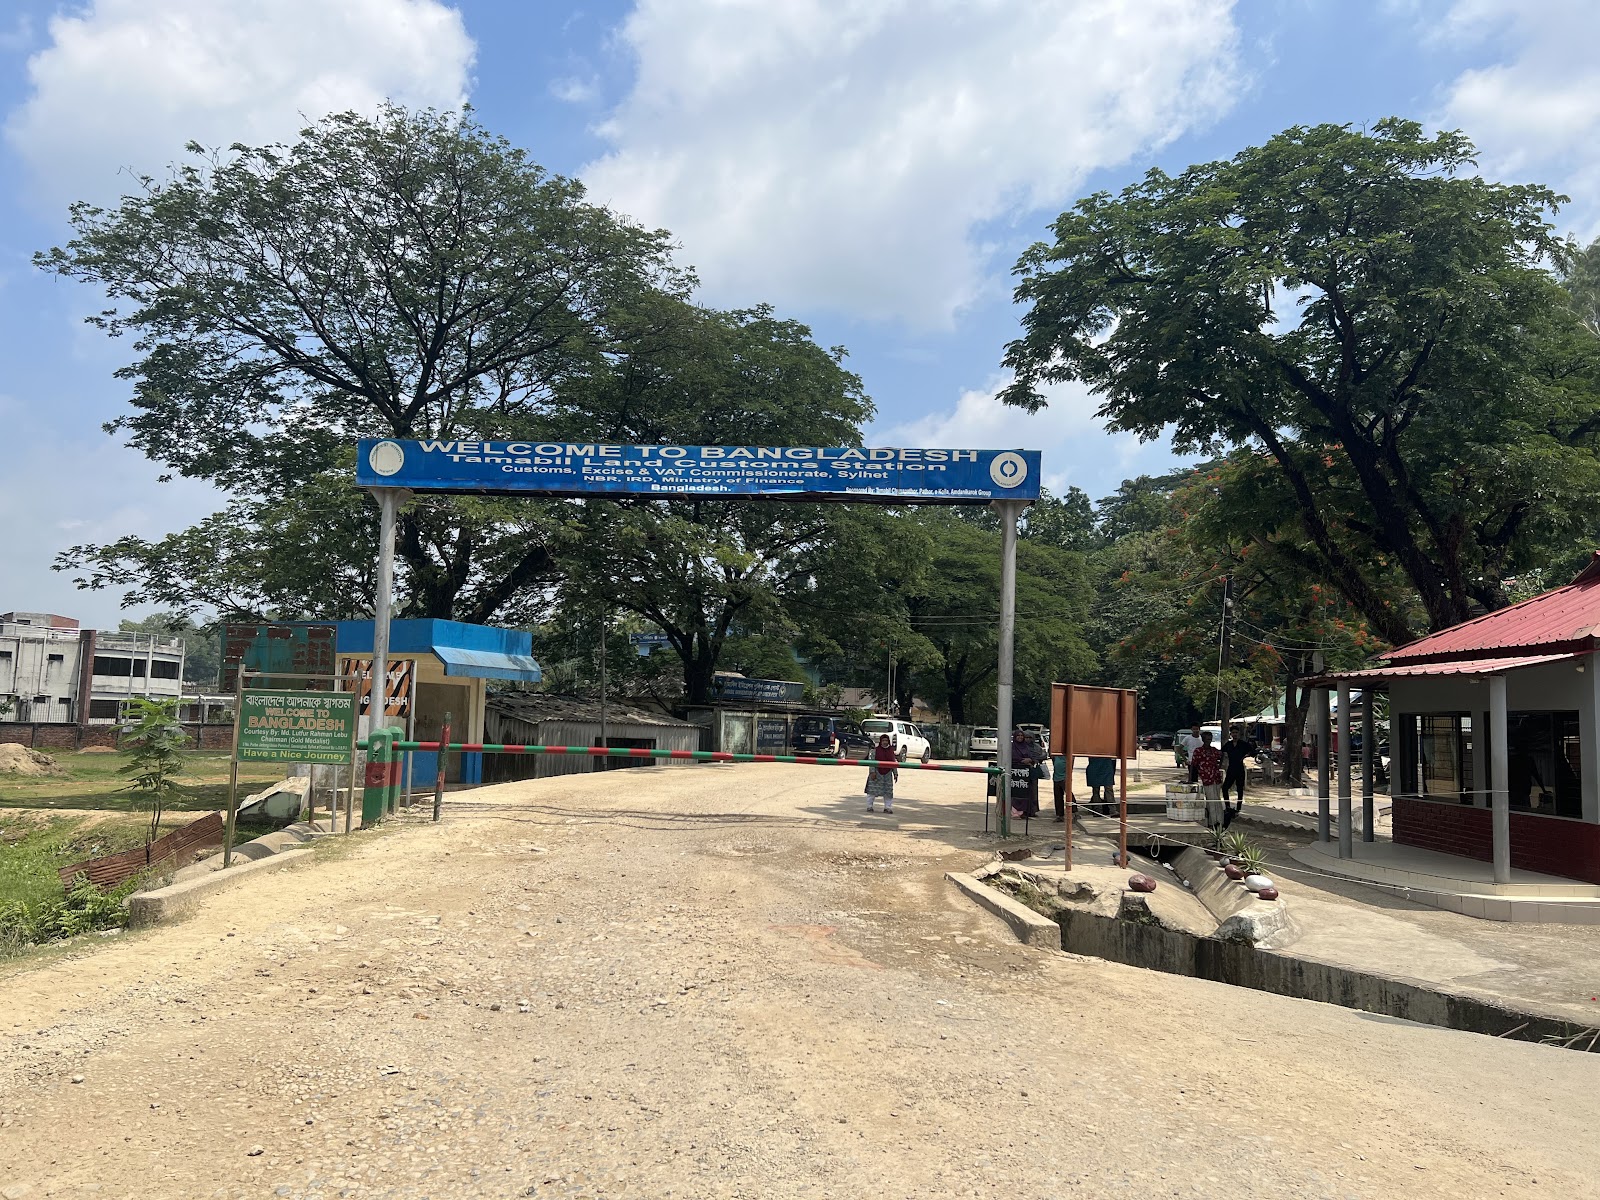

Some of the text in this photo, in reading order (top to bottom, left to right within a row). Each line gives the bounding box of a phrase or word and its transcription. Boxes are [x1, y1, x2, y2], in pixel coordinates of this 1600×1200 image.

[418, 441, 977, 462] WELCOME TO BANGLADESH
[446, 454, 947, 471] Tamabil Land Customs Station
[501, 465, 889, 479] Customs, Excise & VAT Commissionerate, Sylhet
[662, 476, 722, 484] Ministry
[651, 484, 732, 492] Bangladesh.
[978, 489, 991, 497] Group
[245, 695, 351, 709] বাংলাদেশে আপনাকে স্বাগতম
[265, 707, 330, 718] WELCOME TO
[248, 716, 345, 731] BANGLADESH
[244, 728, 269, 737] Courtesy
[270, 728, 280, 736] By:
[305, 737, 330, 745] Medalist)
[243, 749, 269, 757] Have
[280, 750, 302, 758] Nice
[304, 751, 345, 761] Journey
